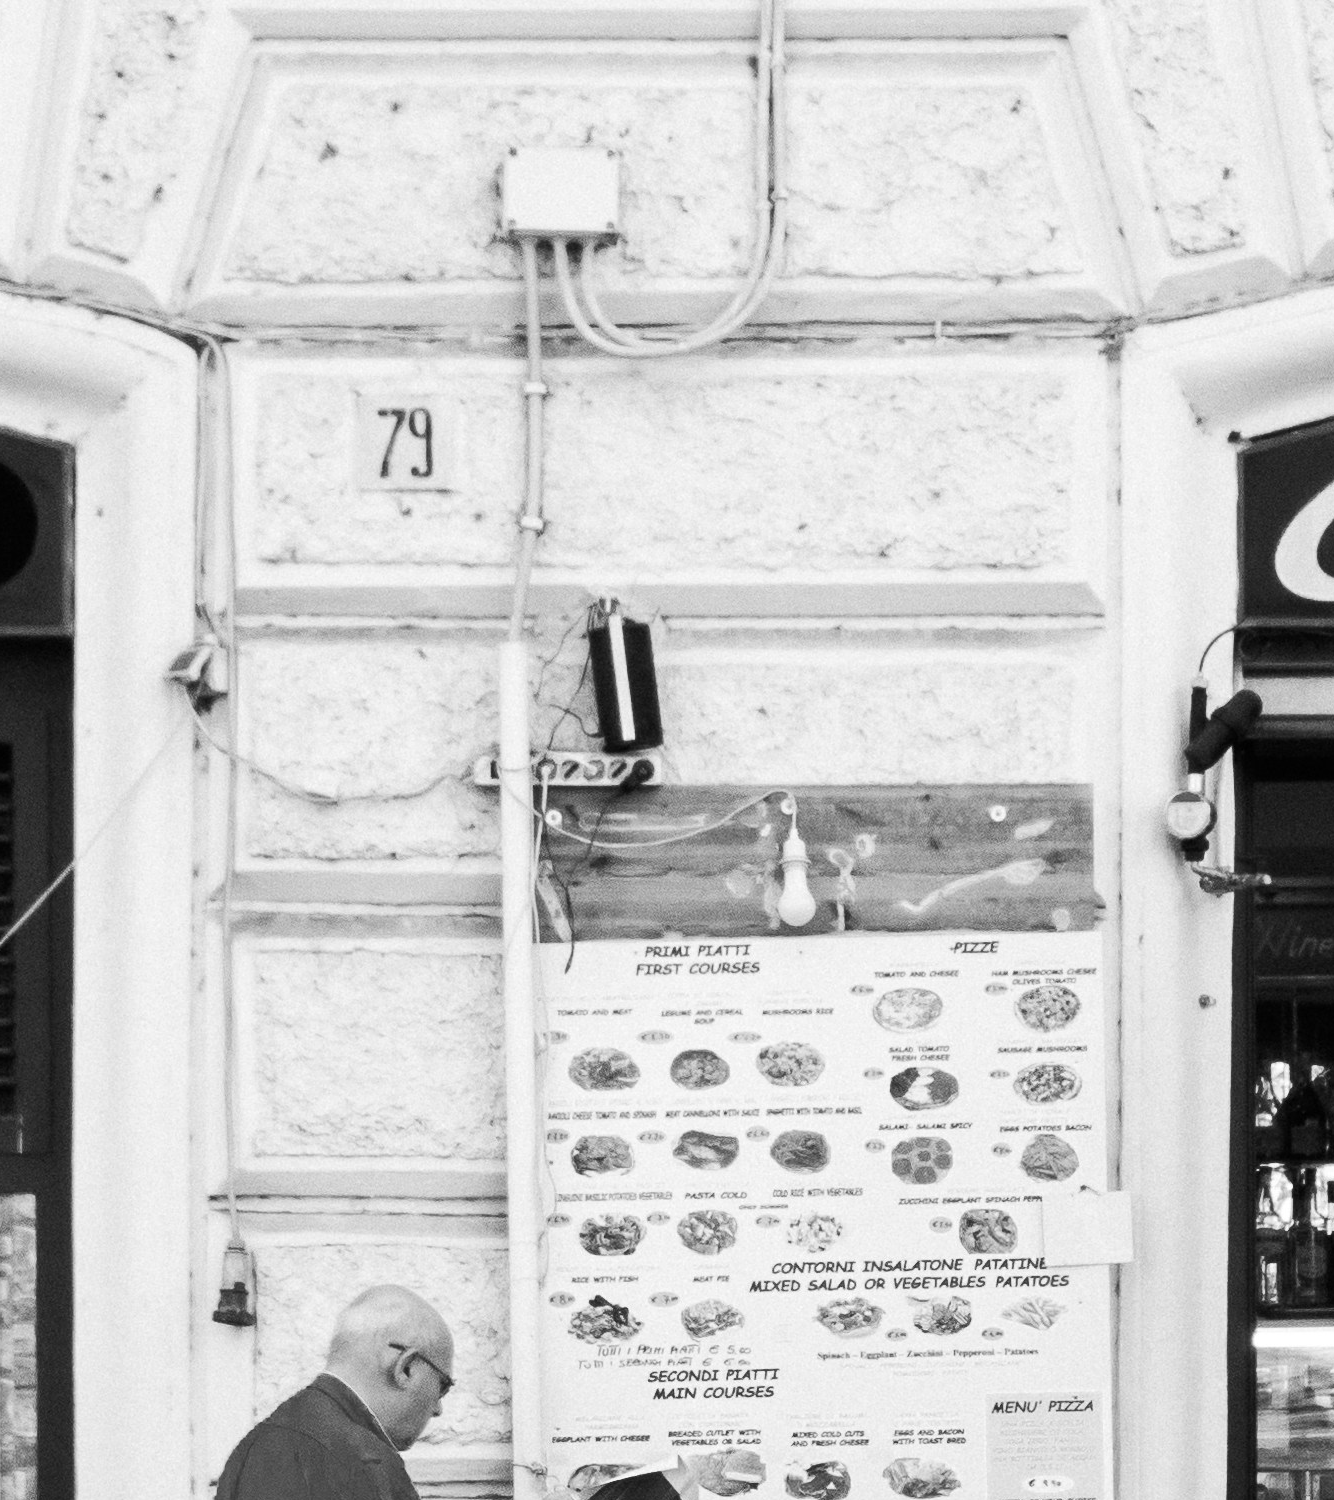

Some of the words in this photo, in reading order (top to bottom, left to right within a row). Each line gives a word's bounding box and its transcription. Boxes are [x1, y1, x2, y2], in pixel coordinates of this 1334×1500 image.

[378, 407, 434, 478] 79
[1253, 916, 1334, 959] Wine
[645, 945, 690, 958] PRIMI
[698, 944, 751, 956] PIATTI
[953, 941, 999, 953] PIZZE
[636, 963, 682, 975] FIRST
[689, 962, 760, 974] COURSES
[685, 1192, 716, 1200] PASTA
[720, 1191, 747, 1199] COLD
[771, 1262, 855, 1274] CONTORNI
[863, 1259, 963, 1272] INSALATONE
[974, 1257, 1047, 1270] PATATINE
[749, 1280, 800, 1292] MIXED
[807, 1280, 857, 1291] SALAD
[864, 1279, 885, 1290] OR
[893, 1277, 986, 1290] VEGETABLES
[995, 1275, 1069, 1288] PATATOES
[817, 1350, 850, 1361] Spinach
[860, 1350, 896, 1361] Eggplant
[906, 1348, 943, 1358] Zucchini
[648, 1369, 719, 1383] SECONDI
[726, 1368, 780, 1381] PIATTI
[653, 1387, 697, 1400] MAIN
[703, 1386, 775, 1399] COURSES
[1048, 1400, 1094, 1412] PIZZA
[938, 1428, 965, 1436] BACON
[918, 1437, 943, 1445] TOAST
